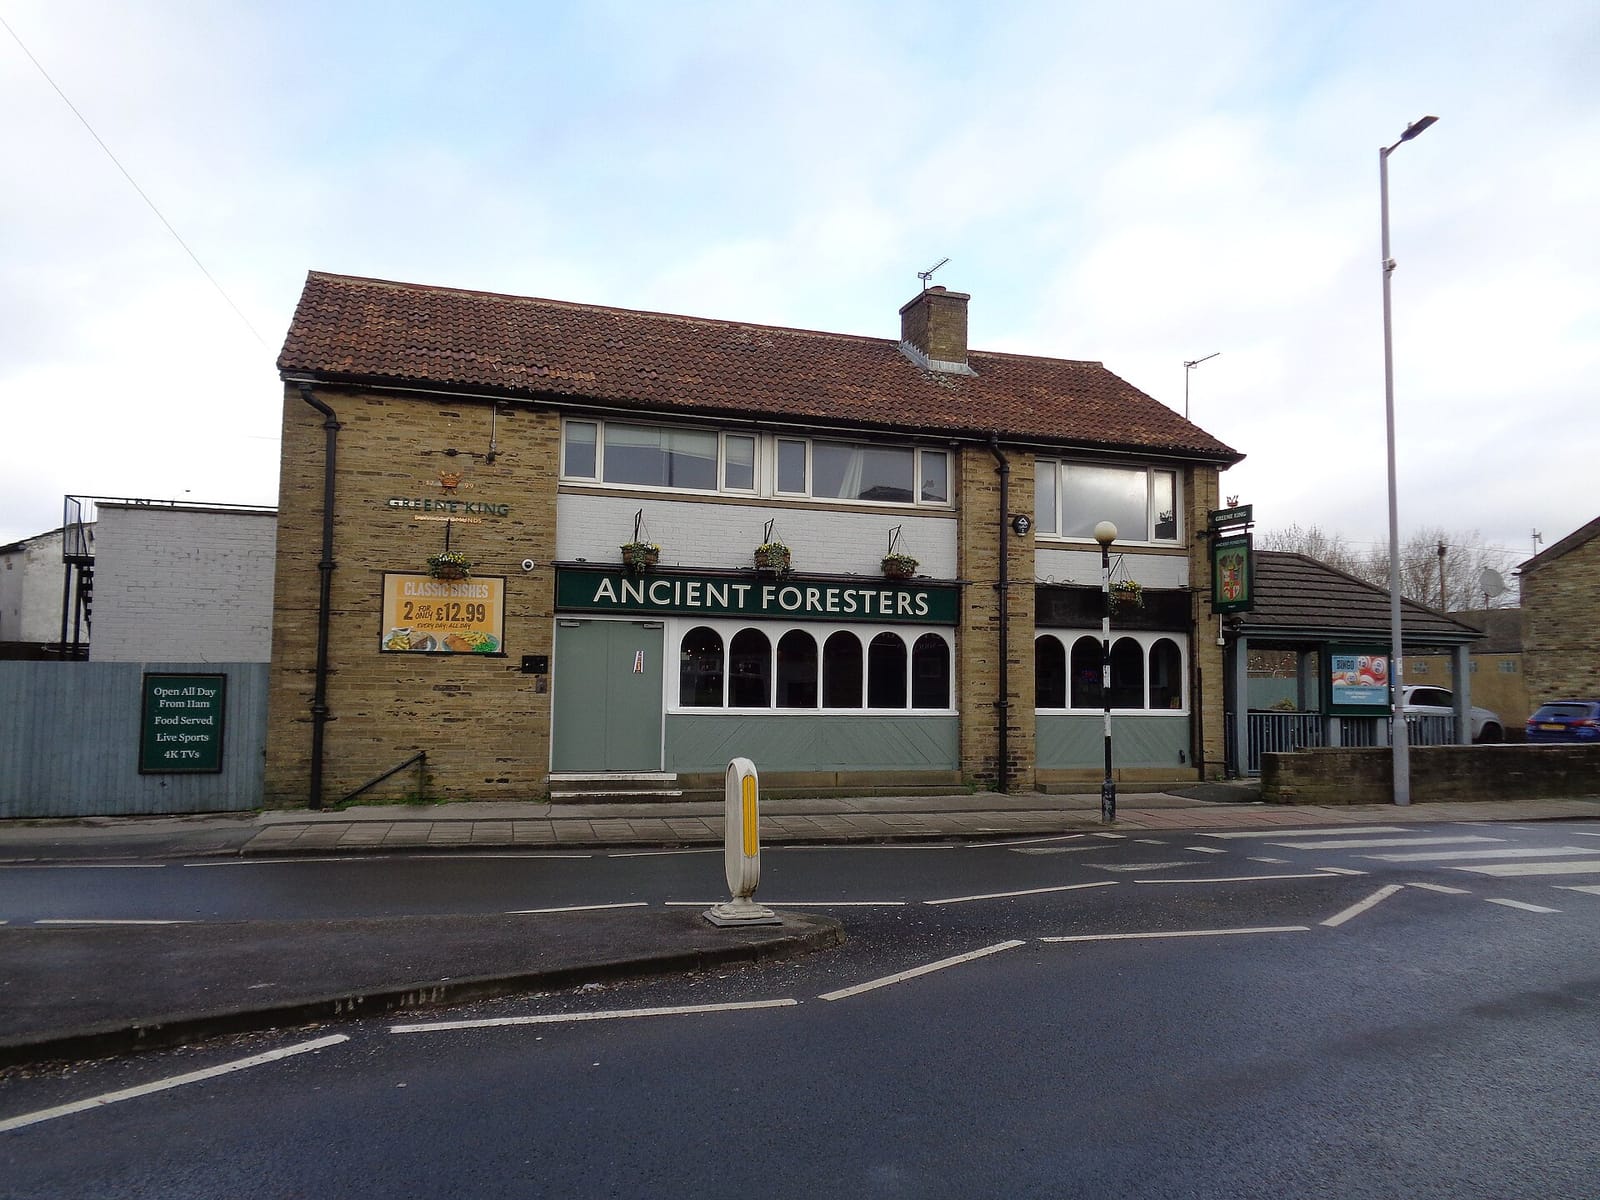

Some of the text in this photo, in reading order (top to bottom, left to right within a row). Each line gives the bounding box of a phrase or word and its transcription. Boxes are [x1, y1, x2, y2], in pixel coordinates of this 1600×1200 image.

[387, 498, 458, 513] GREENE
[465, 501, 509, 518] KING
[404, 581, 489, 599] CLASSIC DISHES
[593, 577, 929, 616] ANCIENT FORESTERS
[403, 601, 486, 623] 2 £12.99
[418, 604, 431, 612] FOR
[414, 610, 434, 621] ONLY
[417, 622, 434, 630] EVERY
[1336, 659, 1355, 670] BINGO
[153, 687, 216, 698] Open All Day
[159, 699, 210, 708] From 11am
[154, 715, 213, 725] Food Served
[156, 733, 209, 743] Live Sports
[163, 750, 200, 759] 4K TVs
